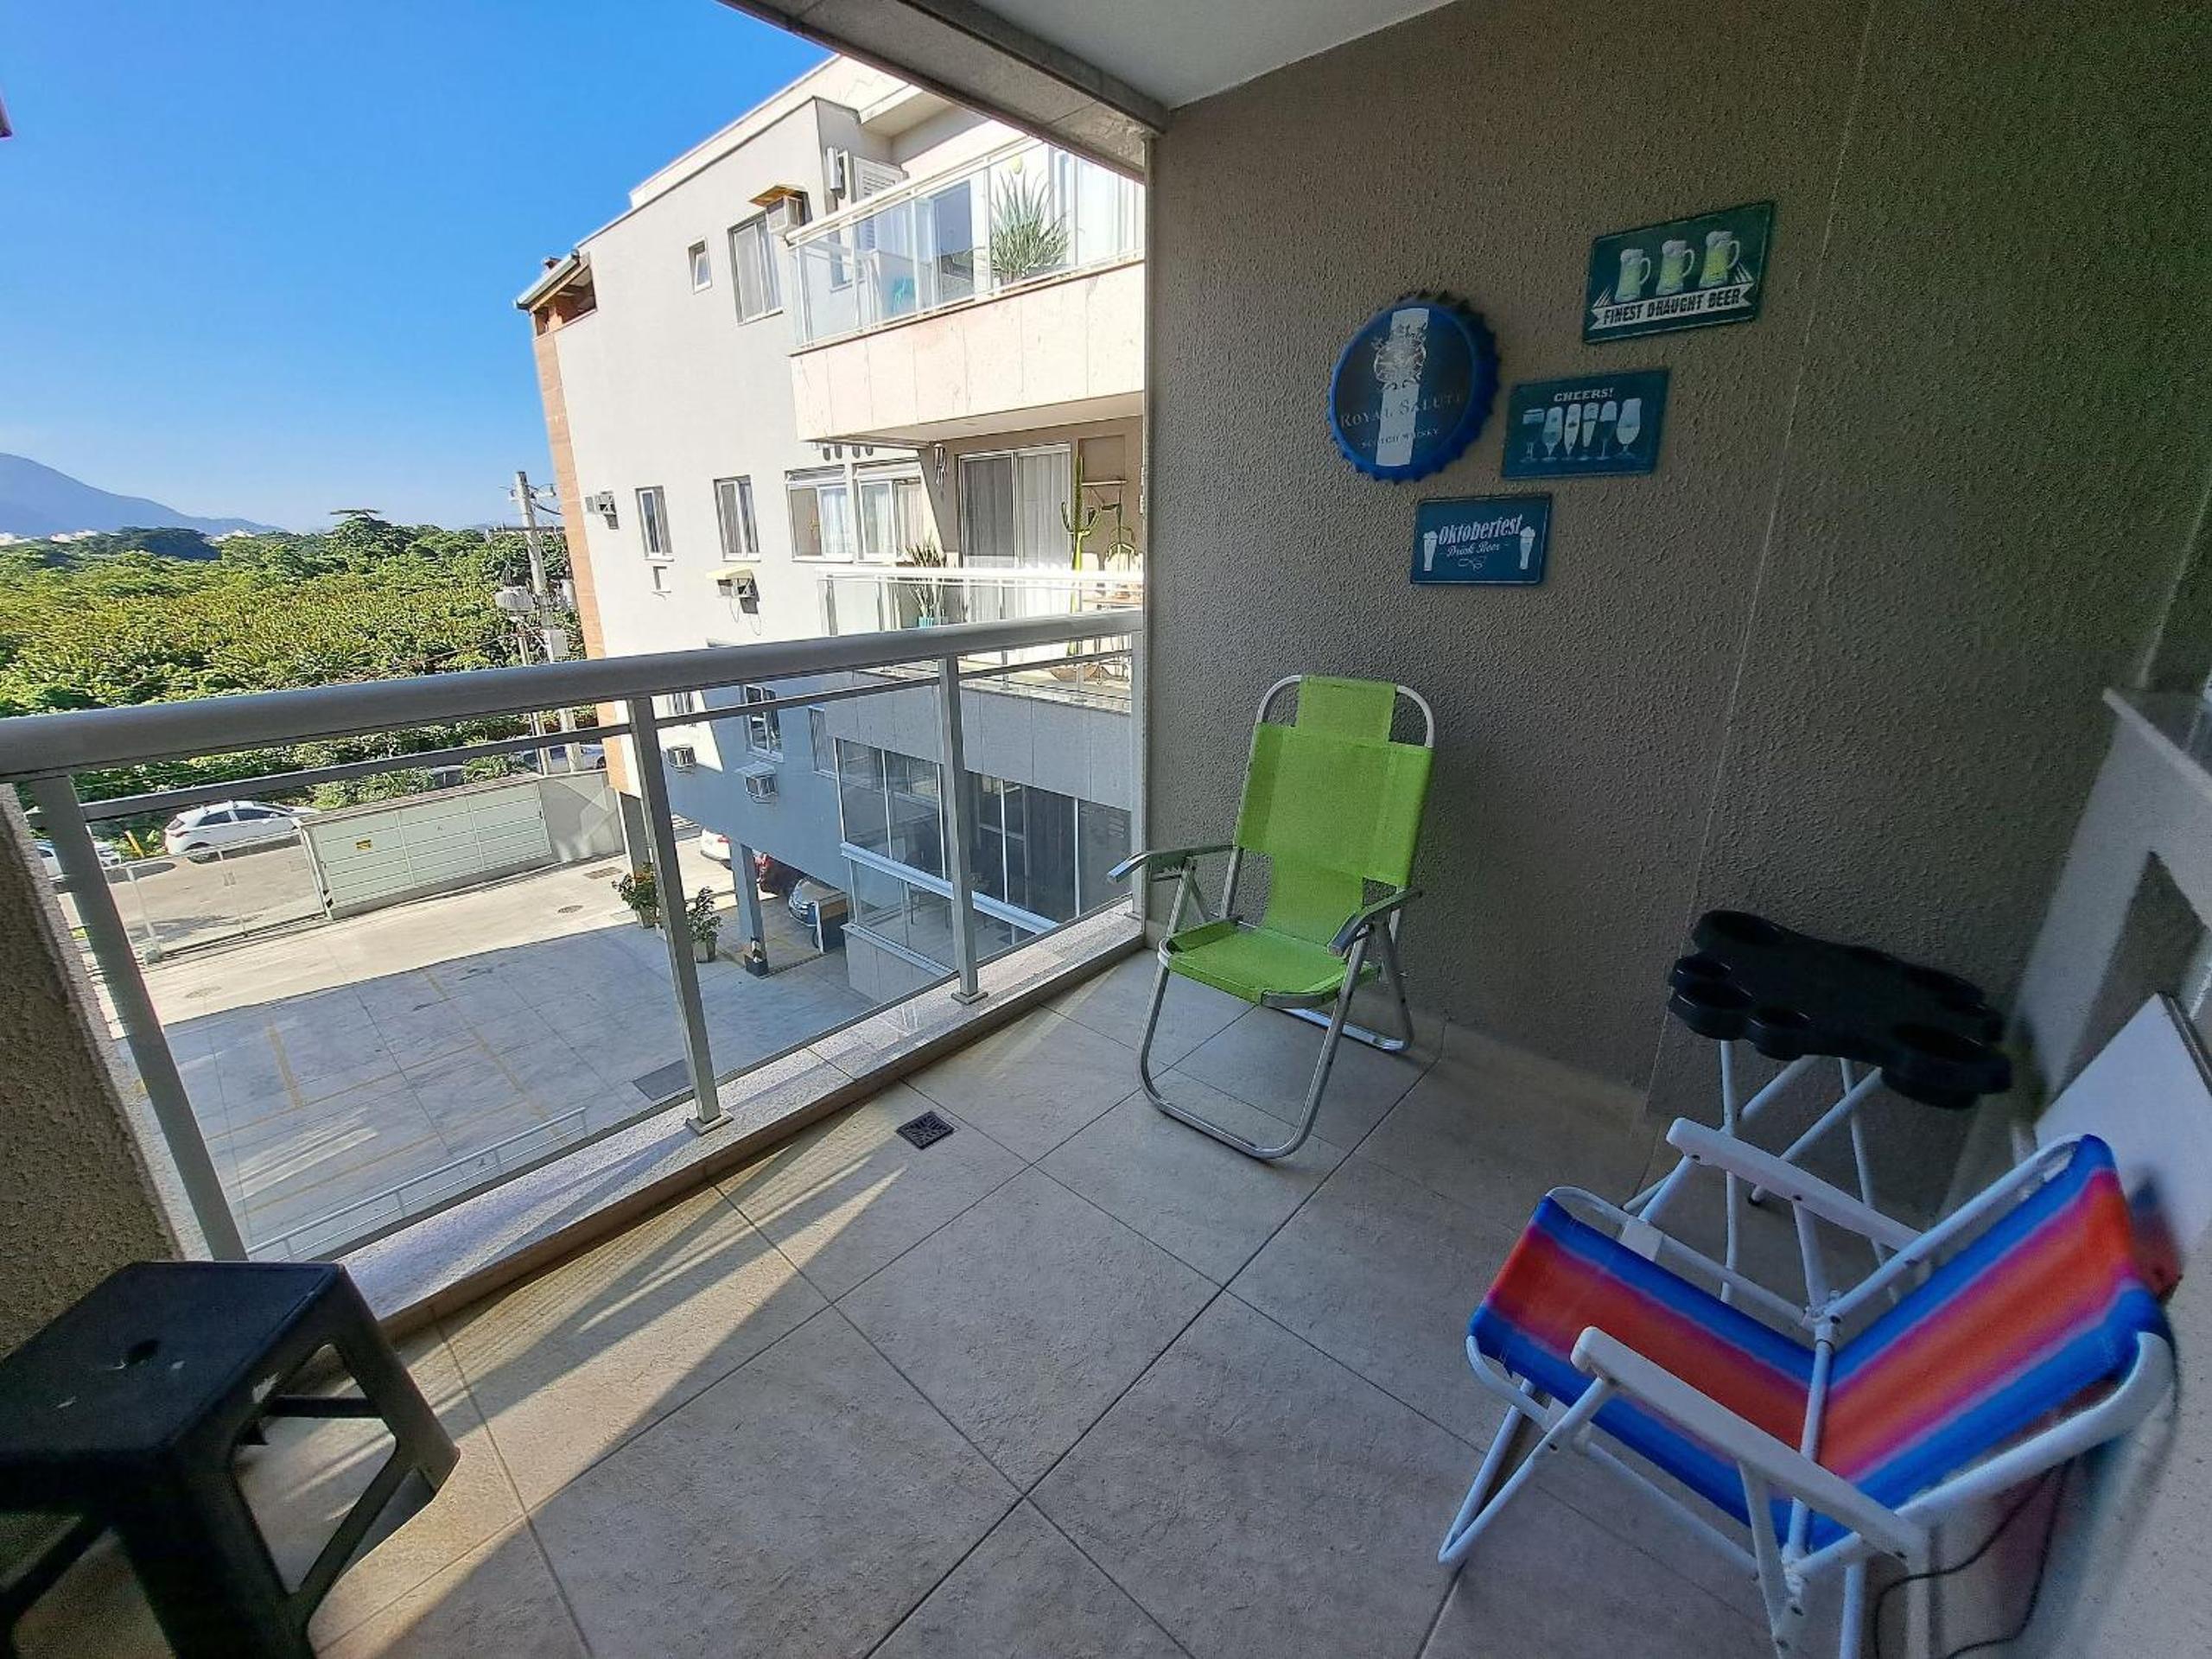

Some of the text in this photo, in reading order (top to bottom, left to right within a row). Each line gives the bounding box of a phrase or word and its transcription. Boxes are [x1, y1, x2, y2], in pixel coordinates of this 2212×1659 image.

[1603, 288, 1741, 325] FINEST DRAUGHT BEER
[1553, 387, 1615, 403] CHEERS!
[1438, 513, 1523, 545] Oktoberfest
